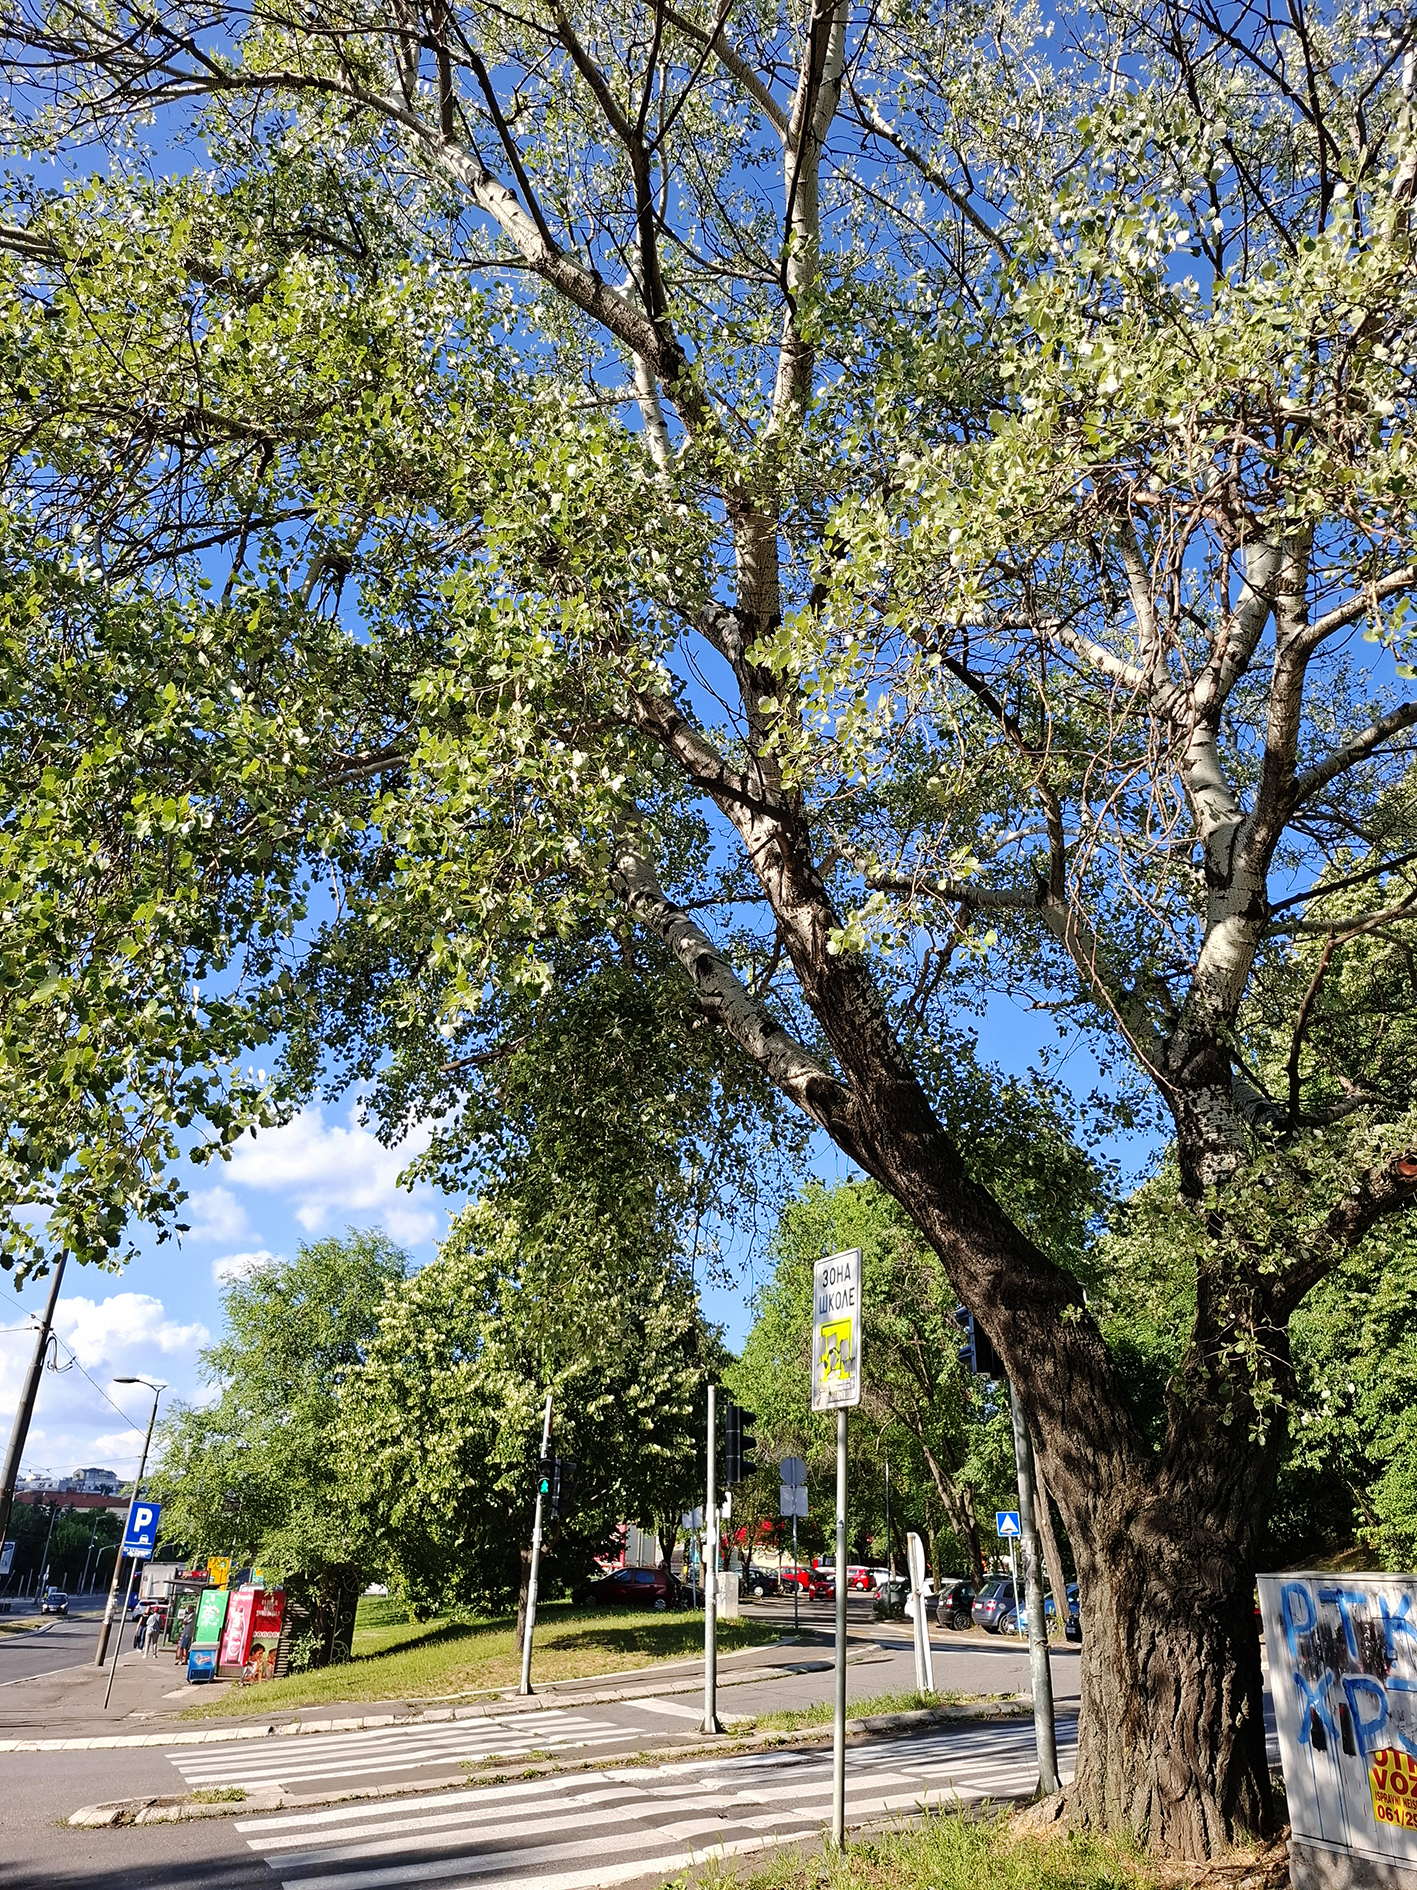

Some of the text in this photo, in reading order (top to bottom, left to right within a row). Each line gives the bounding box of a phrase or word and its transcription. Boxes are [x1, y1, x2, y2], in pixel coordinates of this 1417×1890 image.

[822, 1263, 851, 1288] ЗОНА
[819, 1287, 855, 1315] ШКОЛЕ
[133, 1507, 153, 1533] P
